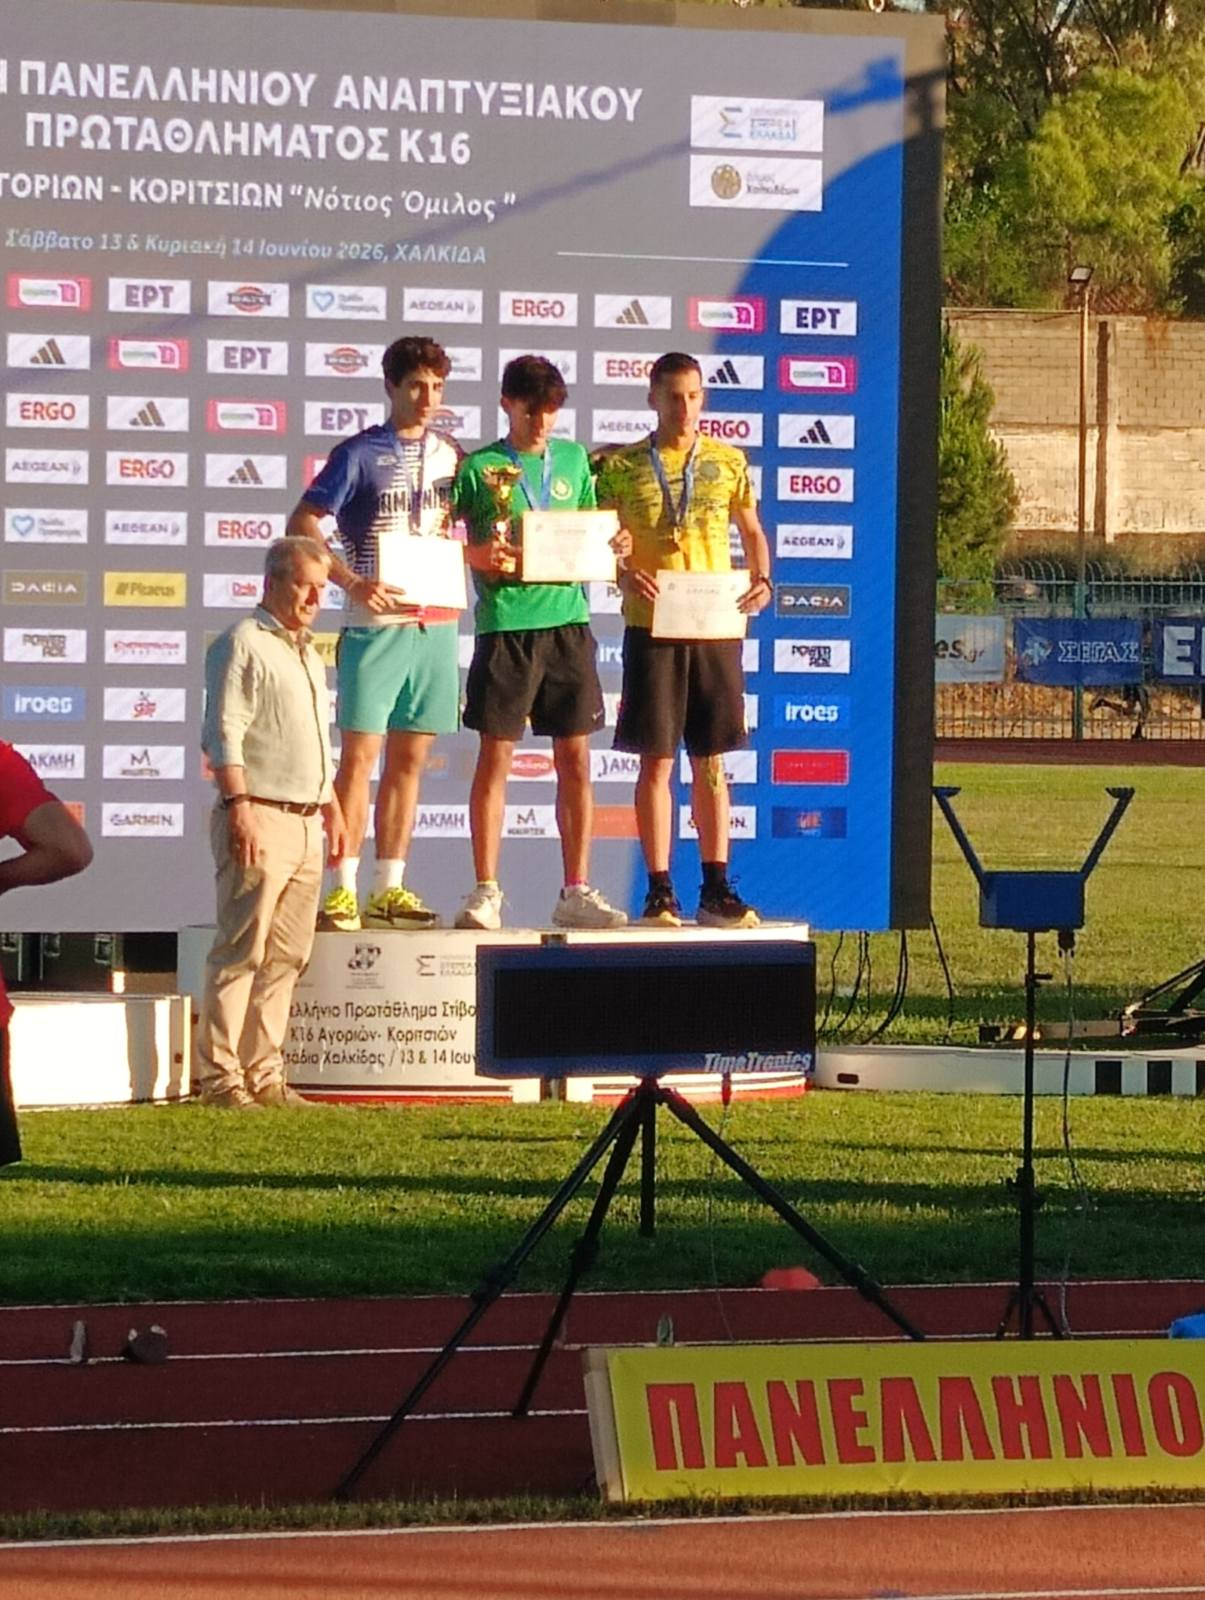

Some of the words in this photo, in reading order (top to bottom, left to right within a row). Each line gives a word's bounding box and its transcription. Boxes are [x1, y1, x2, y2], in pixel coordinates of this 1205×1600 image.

[20, 60, 317, 107] ΠΑΝΕΛΛΗΝΙΟΥ
[334, 74, 643, 122] ΑΝΑΠΤΥΞΙΑΚΟΥ
[25, 112, 390, 162] ΠΡΩΤΑΘΛΗΜΑΤΟΣ
[129, 177, 283, 208] ΚΟΡΙΤΣΙΩΝ
[5, 227, 94, 252] Σάββατο
[100, 233, 122, 250] 13
[126, 234, 138, 250] &
[145, 235, 226, 258] Κυριακή
[231, 238, 254, 255] 14
[259, 239, 332, 260] Ιουνίου
[394, 244, 486, 264] ΧΑΛΚΙΔΑ
[511, 299, 565, 318] ERGO
[20, 401, 76, 421] ERGO
[700, 420, 750, 439] ERGO
[119, 458, 175, 479] ERGO
[790, 475, 841, 494] ERGO
[217, 520, 272, 540] ERGO
[11, 582, 78, 593] DACIA
[783, 597, 843, 606] DACIA
[1058, 640, 1140, 663] ΣΕΓΑΣ
[14, 694, 72, 714] iroes
[786, 703, 839, 722] iroes
[345, 1000, 437, 1021] Πρωτάθλημα
[387, 1025, 457, 1045] Κοριτσιών
[323, 1049, 385, 1068] Χαλκίδας
[401, 1050, 414, 1065] 13
[419, 1050, 427, 1064] &
[433, 1049, 447, 1064] 14
[704, 1050, 812, 1074] TimeTronics
[646, 1371, 1205, 1471] ΠΑΝΕΛΛΗΝΙΟ
